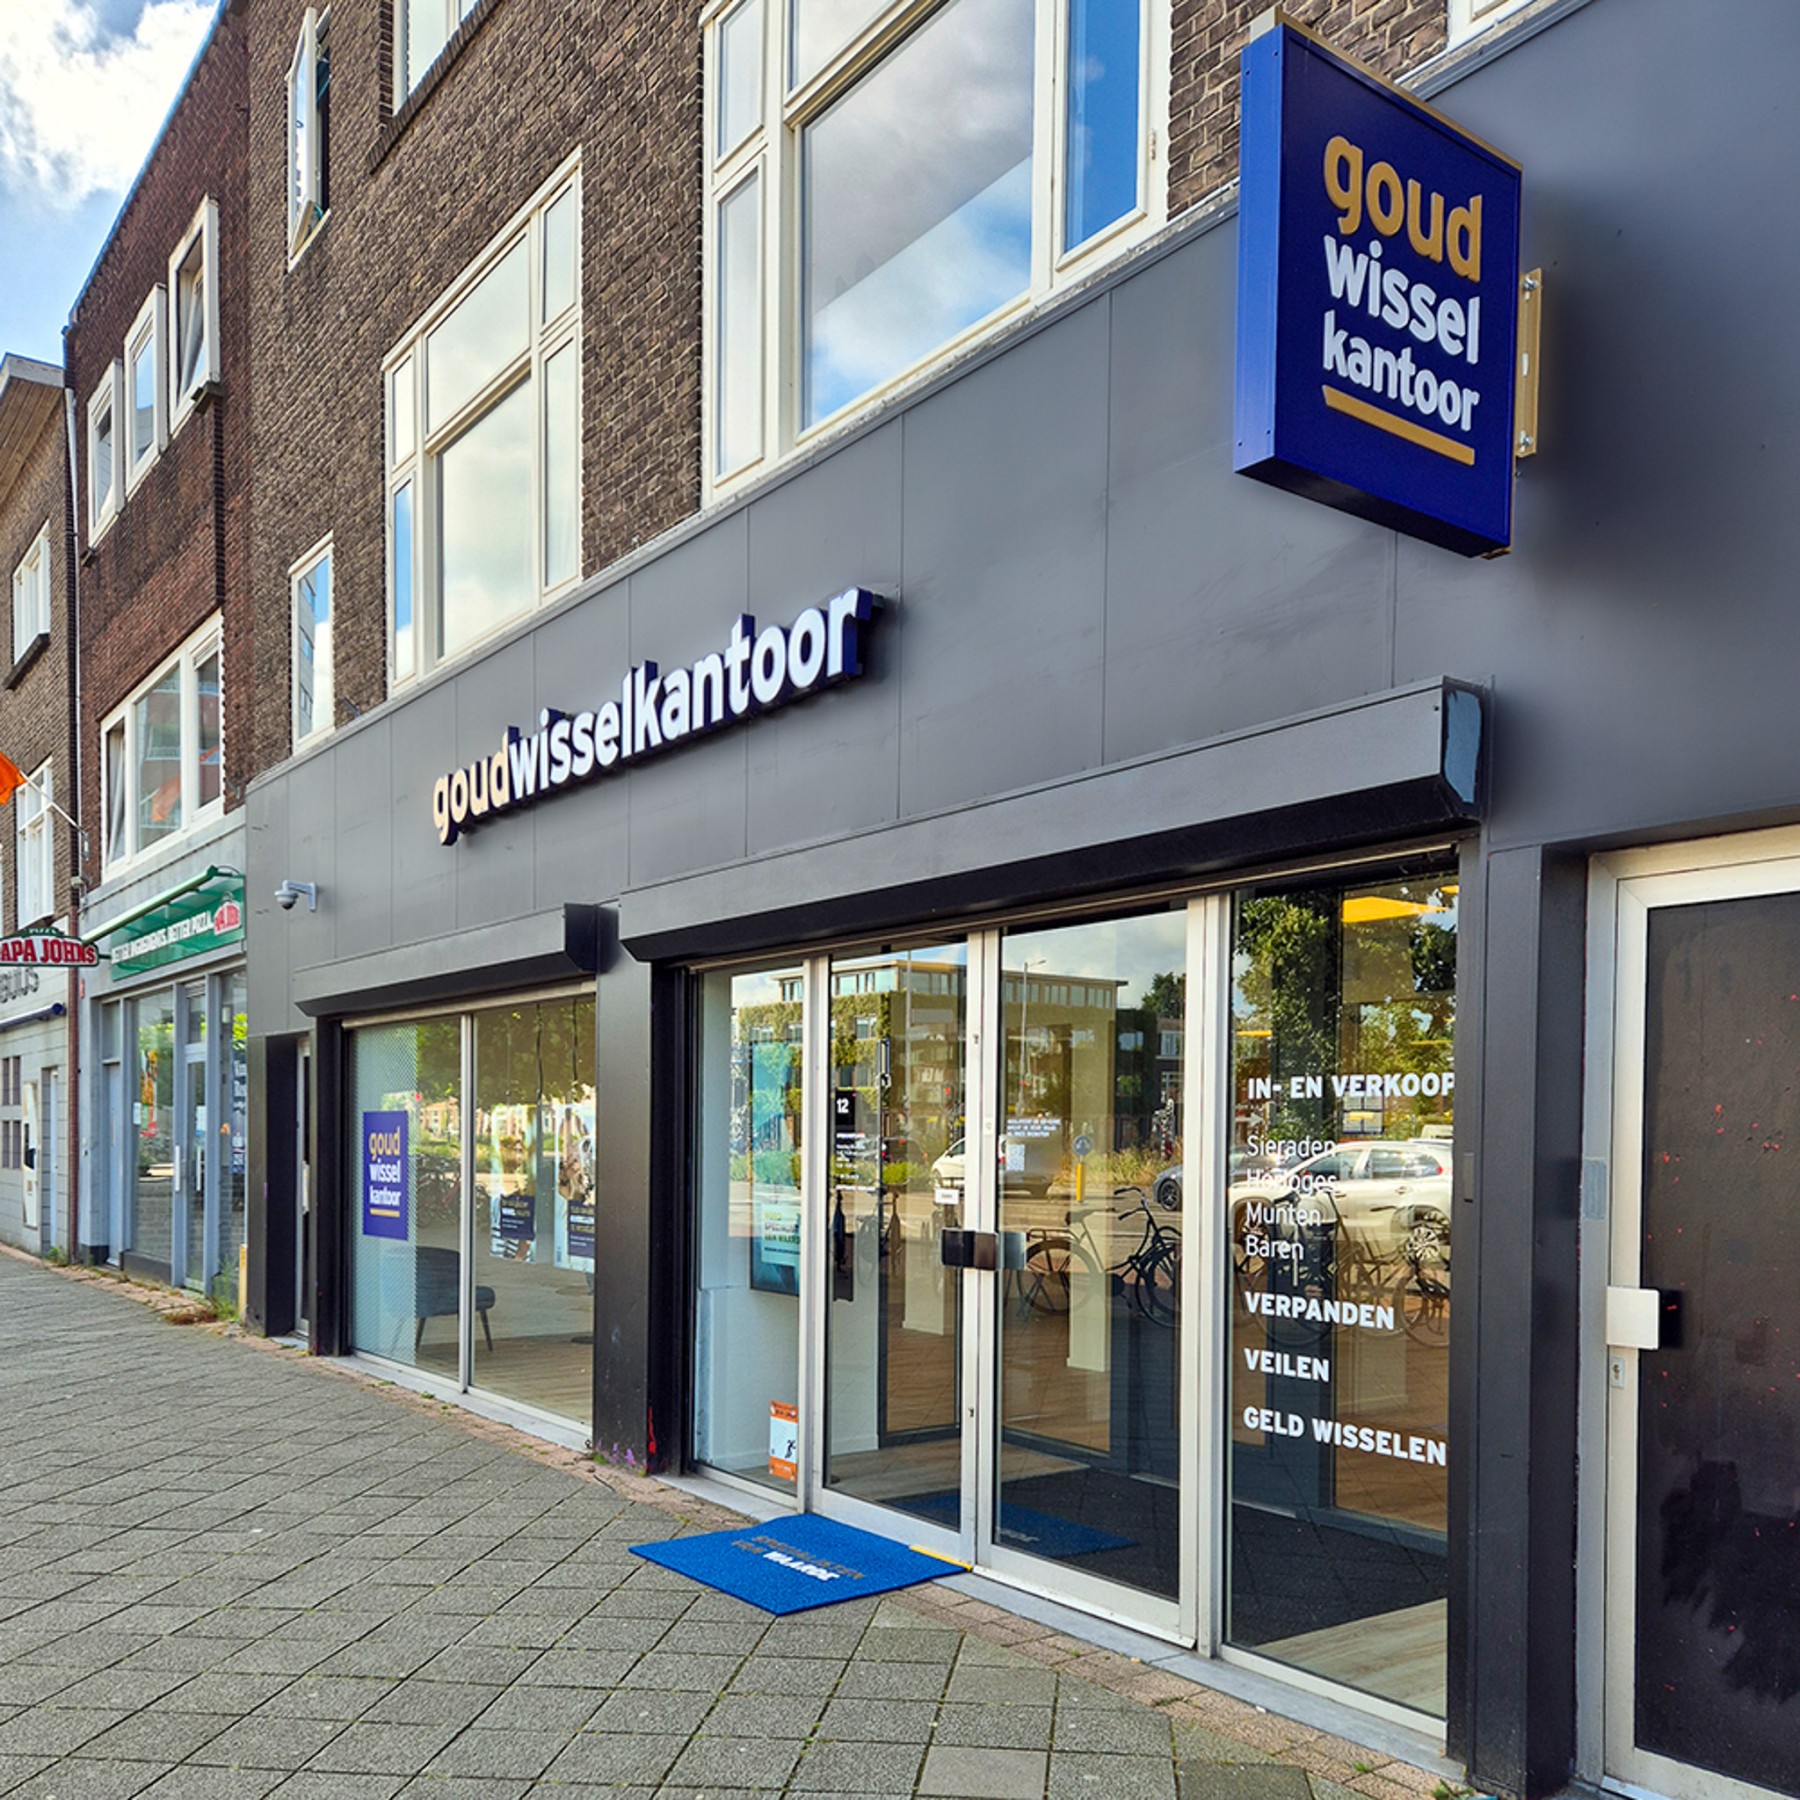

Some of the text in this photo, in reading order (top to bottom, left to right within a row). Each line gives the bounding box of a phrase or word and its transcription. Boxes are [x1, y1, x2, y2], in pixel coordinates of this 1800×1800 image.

[1323, 134, 1483, 283] goud
[1323, 233, 1481, 365] wissel
[1322, 309, 1481, 432] kantoor
[432, 586, 864, 846] goudwisselkantoor
[40, 938, 96, 963] JOHNS
[1247, 1072, 1454, 1100] IN- EN VERKOOP
[836, 1098, 849, 1114] 12
[368, 1126, 401, 1162] goud
[1246, 1134, 1337, 1158] Sieraden
[368, 1158, 401, 1184] wissel
[1246, 1200, 1321, 1227] Munten
[1245, 1234, 1305, 1261] Baren
[1244, 1290, 1395, 1331] VERPANDEN
[1243, 1346, 1330, 1382] VEILEN
[1242, 1405, 1448, 1467] GELD WISSELEN
